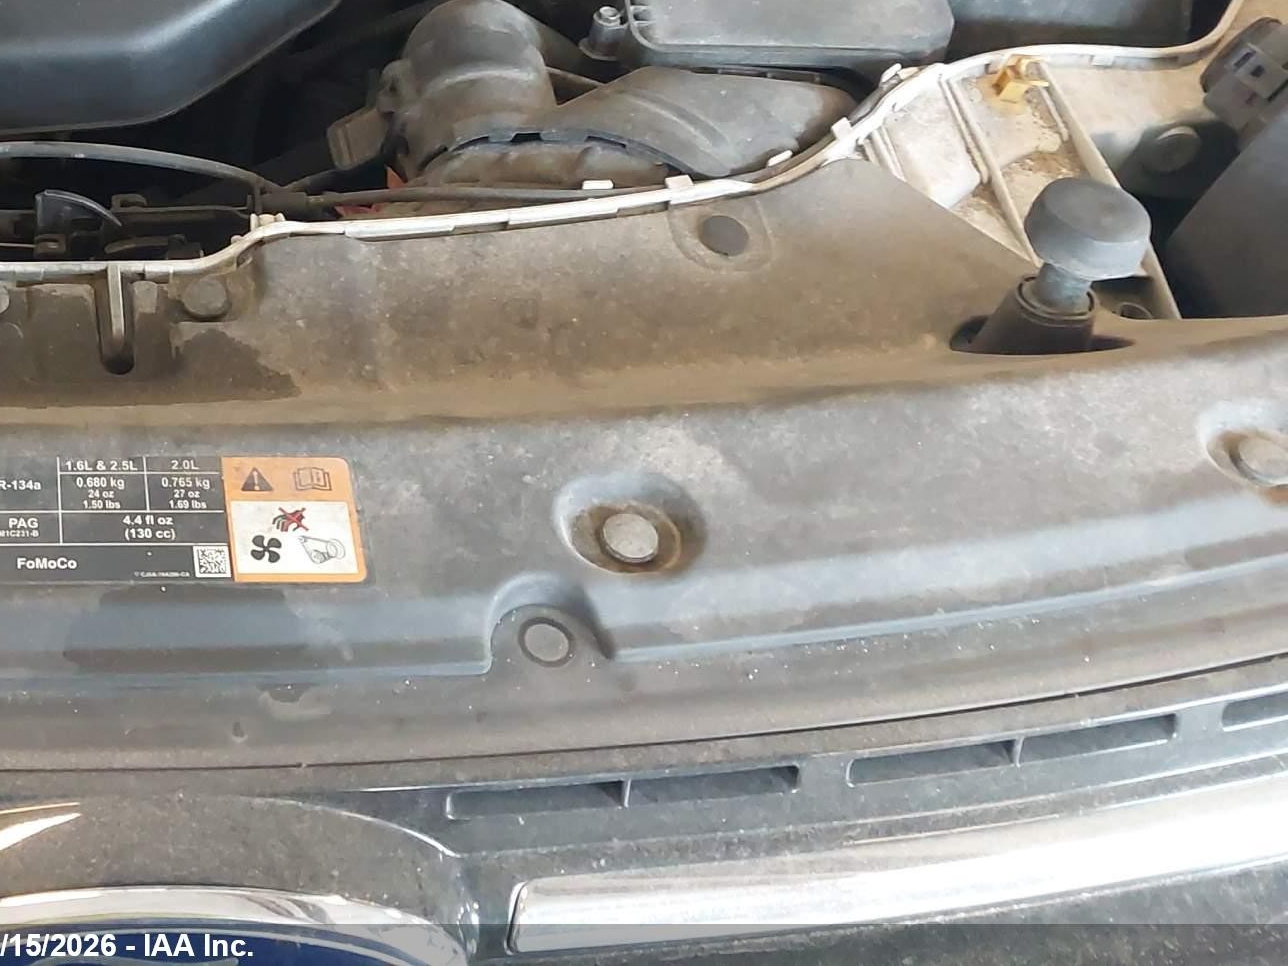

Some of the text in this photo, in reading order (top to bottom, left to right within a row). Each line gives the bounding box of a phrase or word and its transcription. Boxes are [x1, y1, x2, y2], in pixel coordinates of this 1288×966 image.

[65, 460, 138, 471] 1.6L & 2.5L
[171, 459, 199, 470] 2.0L
[76, 476, 125, 490] 0.680 kg
[161, 476, 210, 490] 0.765 kg
[88, 489, 115, 498] 24 oz
[173, 489, 200, 498] 27 oz
[82, 500, 121, 509] 1.50 lbs
[168, 500, 207, 509] 1.69 lbs
[8, 517, 39, 529] PAG
[122, 515, 173, 525] 4.4 fl oz
[124, 529, 176, 540] (130 cc)
[16, 557, 77, 570] FoMoCo
